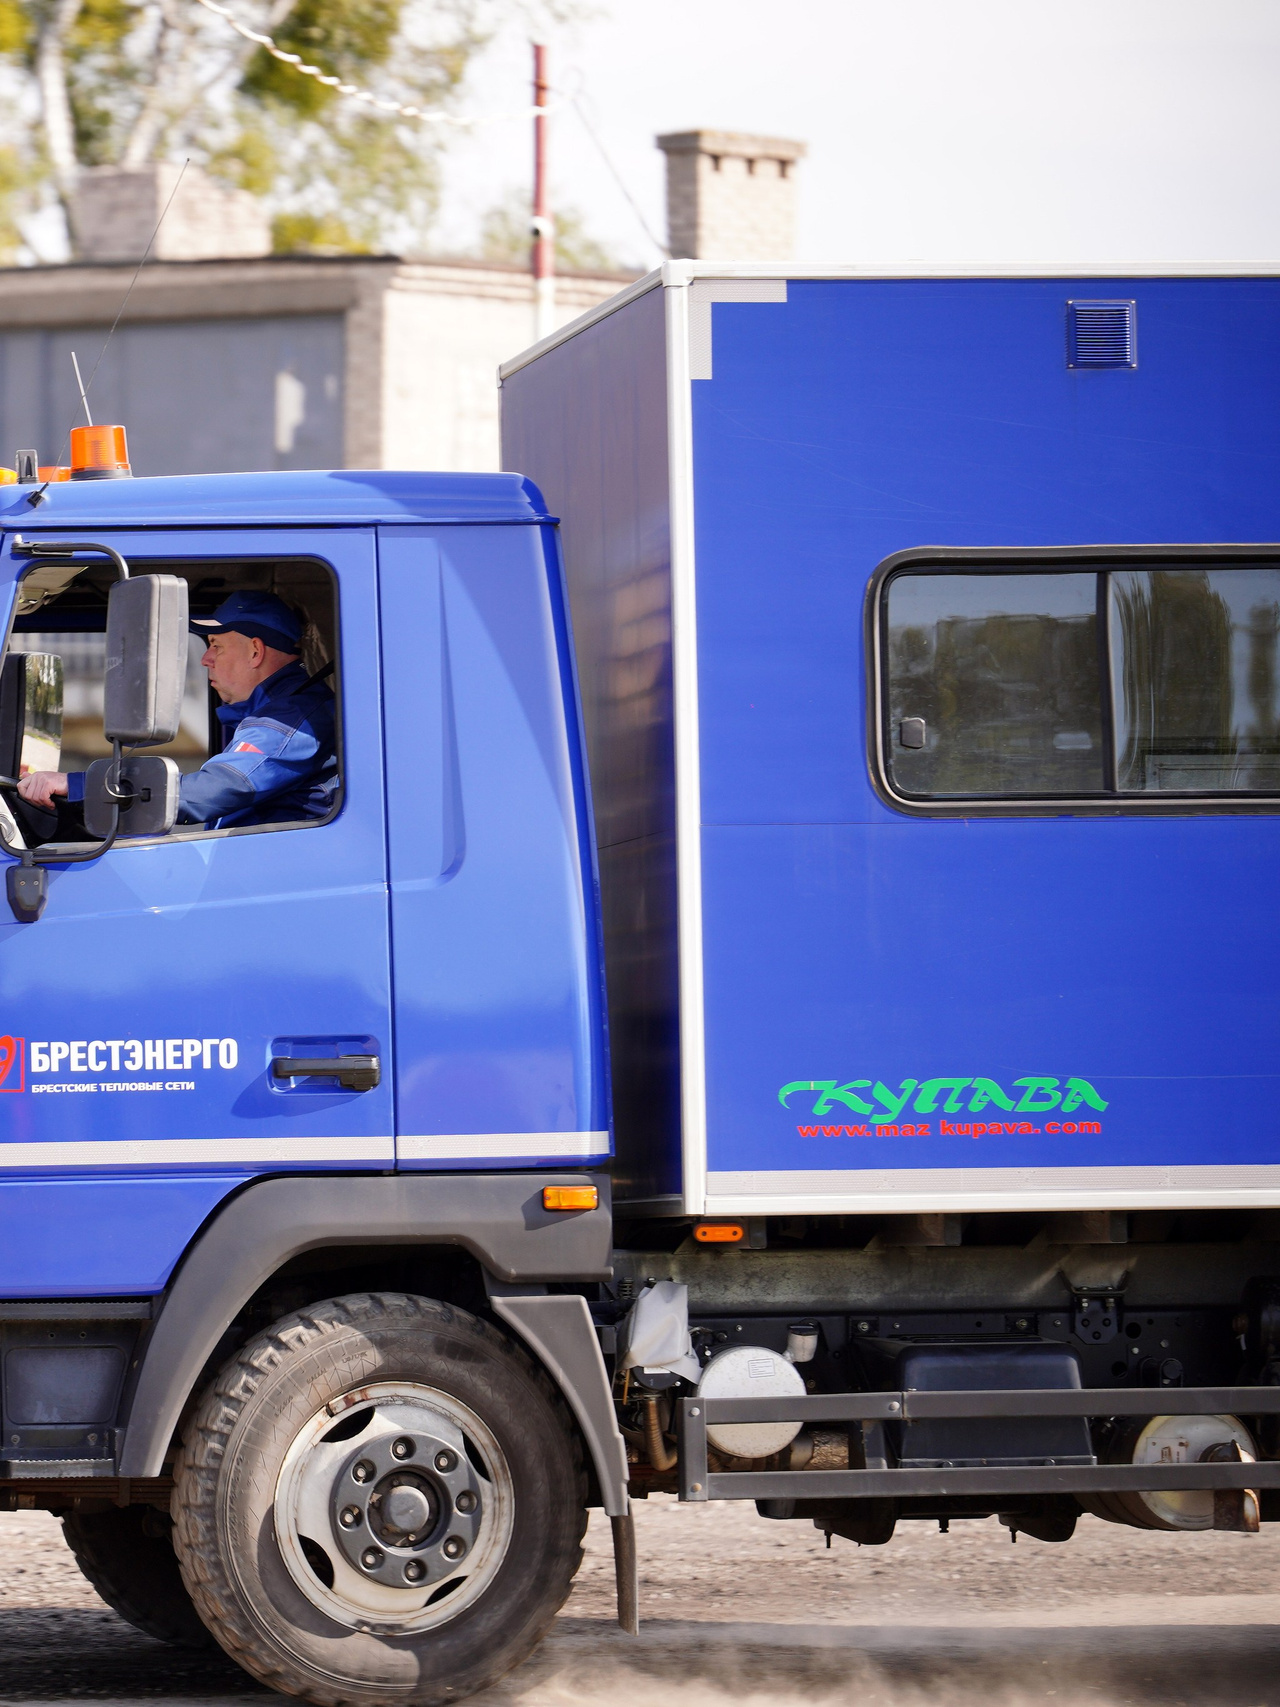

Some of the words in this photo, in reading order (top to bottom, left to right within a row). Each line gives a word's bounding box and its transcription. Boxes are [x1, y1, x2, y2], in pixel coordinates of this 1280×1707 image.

[30, 1037, 239, 1073] БРЕСТЭНЕРГО
[31, 1083, 98, 1094] БРЕСТСКИЕ
[98, 1082, 164, 1092] ТЕПЛОВЫЕ
[164, 1081, 195, 1091] СЕТИ
[777, 1076, 1109, 1125] КУПАВА
